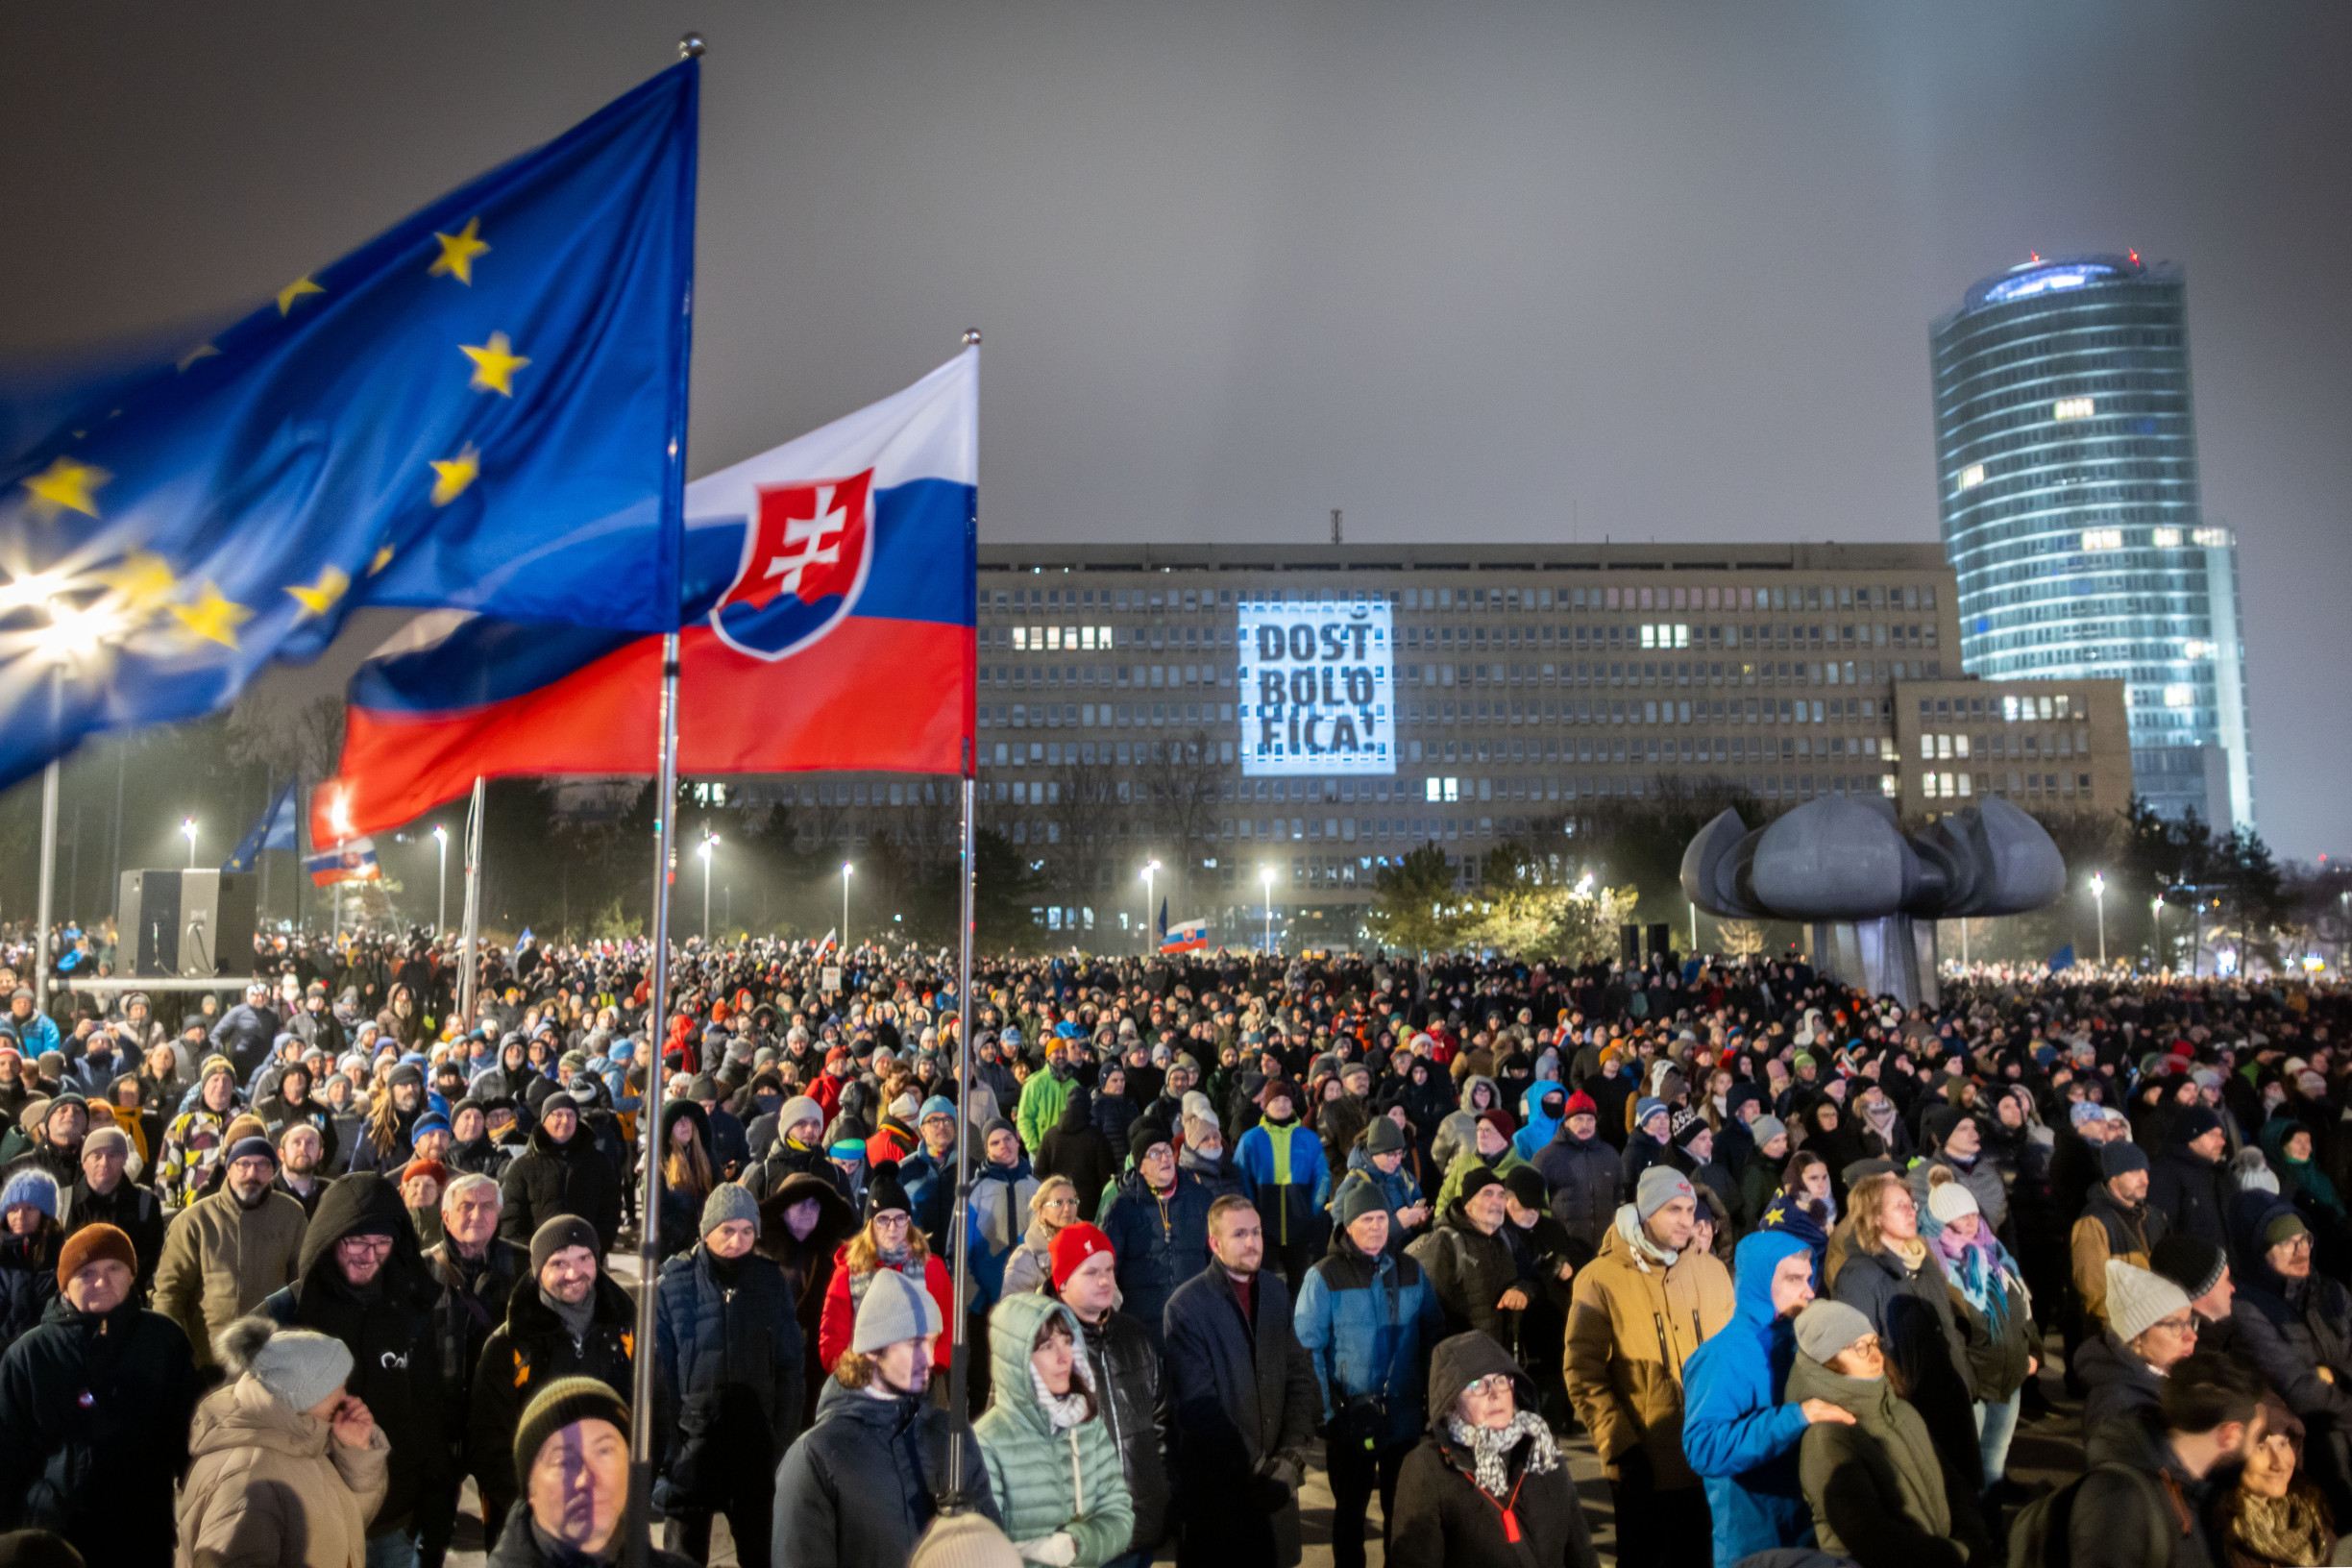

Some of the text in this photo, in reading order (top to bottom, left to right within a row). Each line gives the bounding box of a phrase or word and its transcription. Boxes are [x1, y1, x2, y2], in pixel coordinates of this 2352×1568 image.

[1259, 609, 1373, 661] DOSŤ
[1260, 669, 1375, 706] BOLO
[1260, 712, 1376, 753] FICA!
